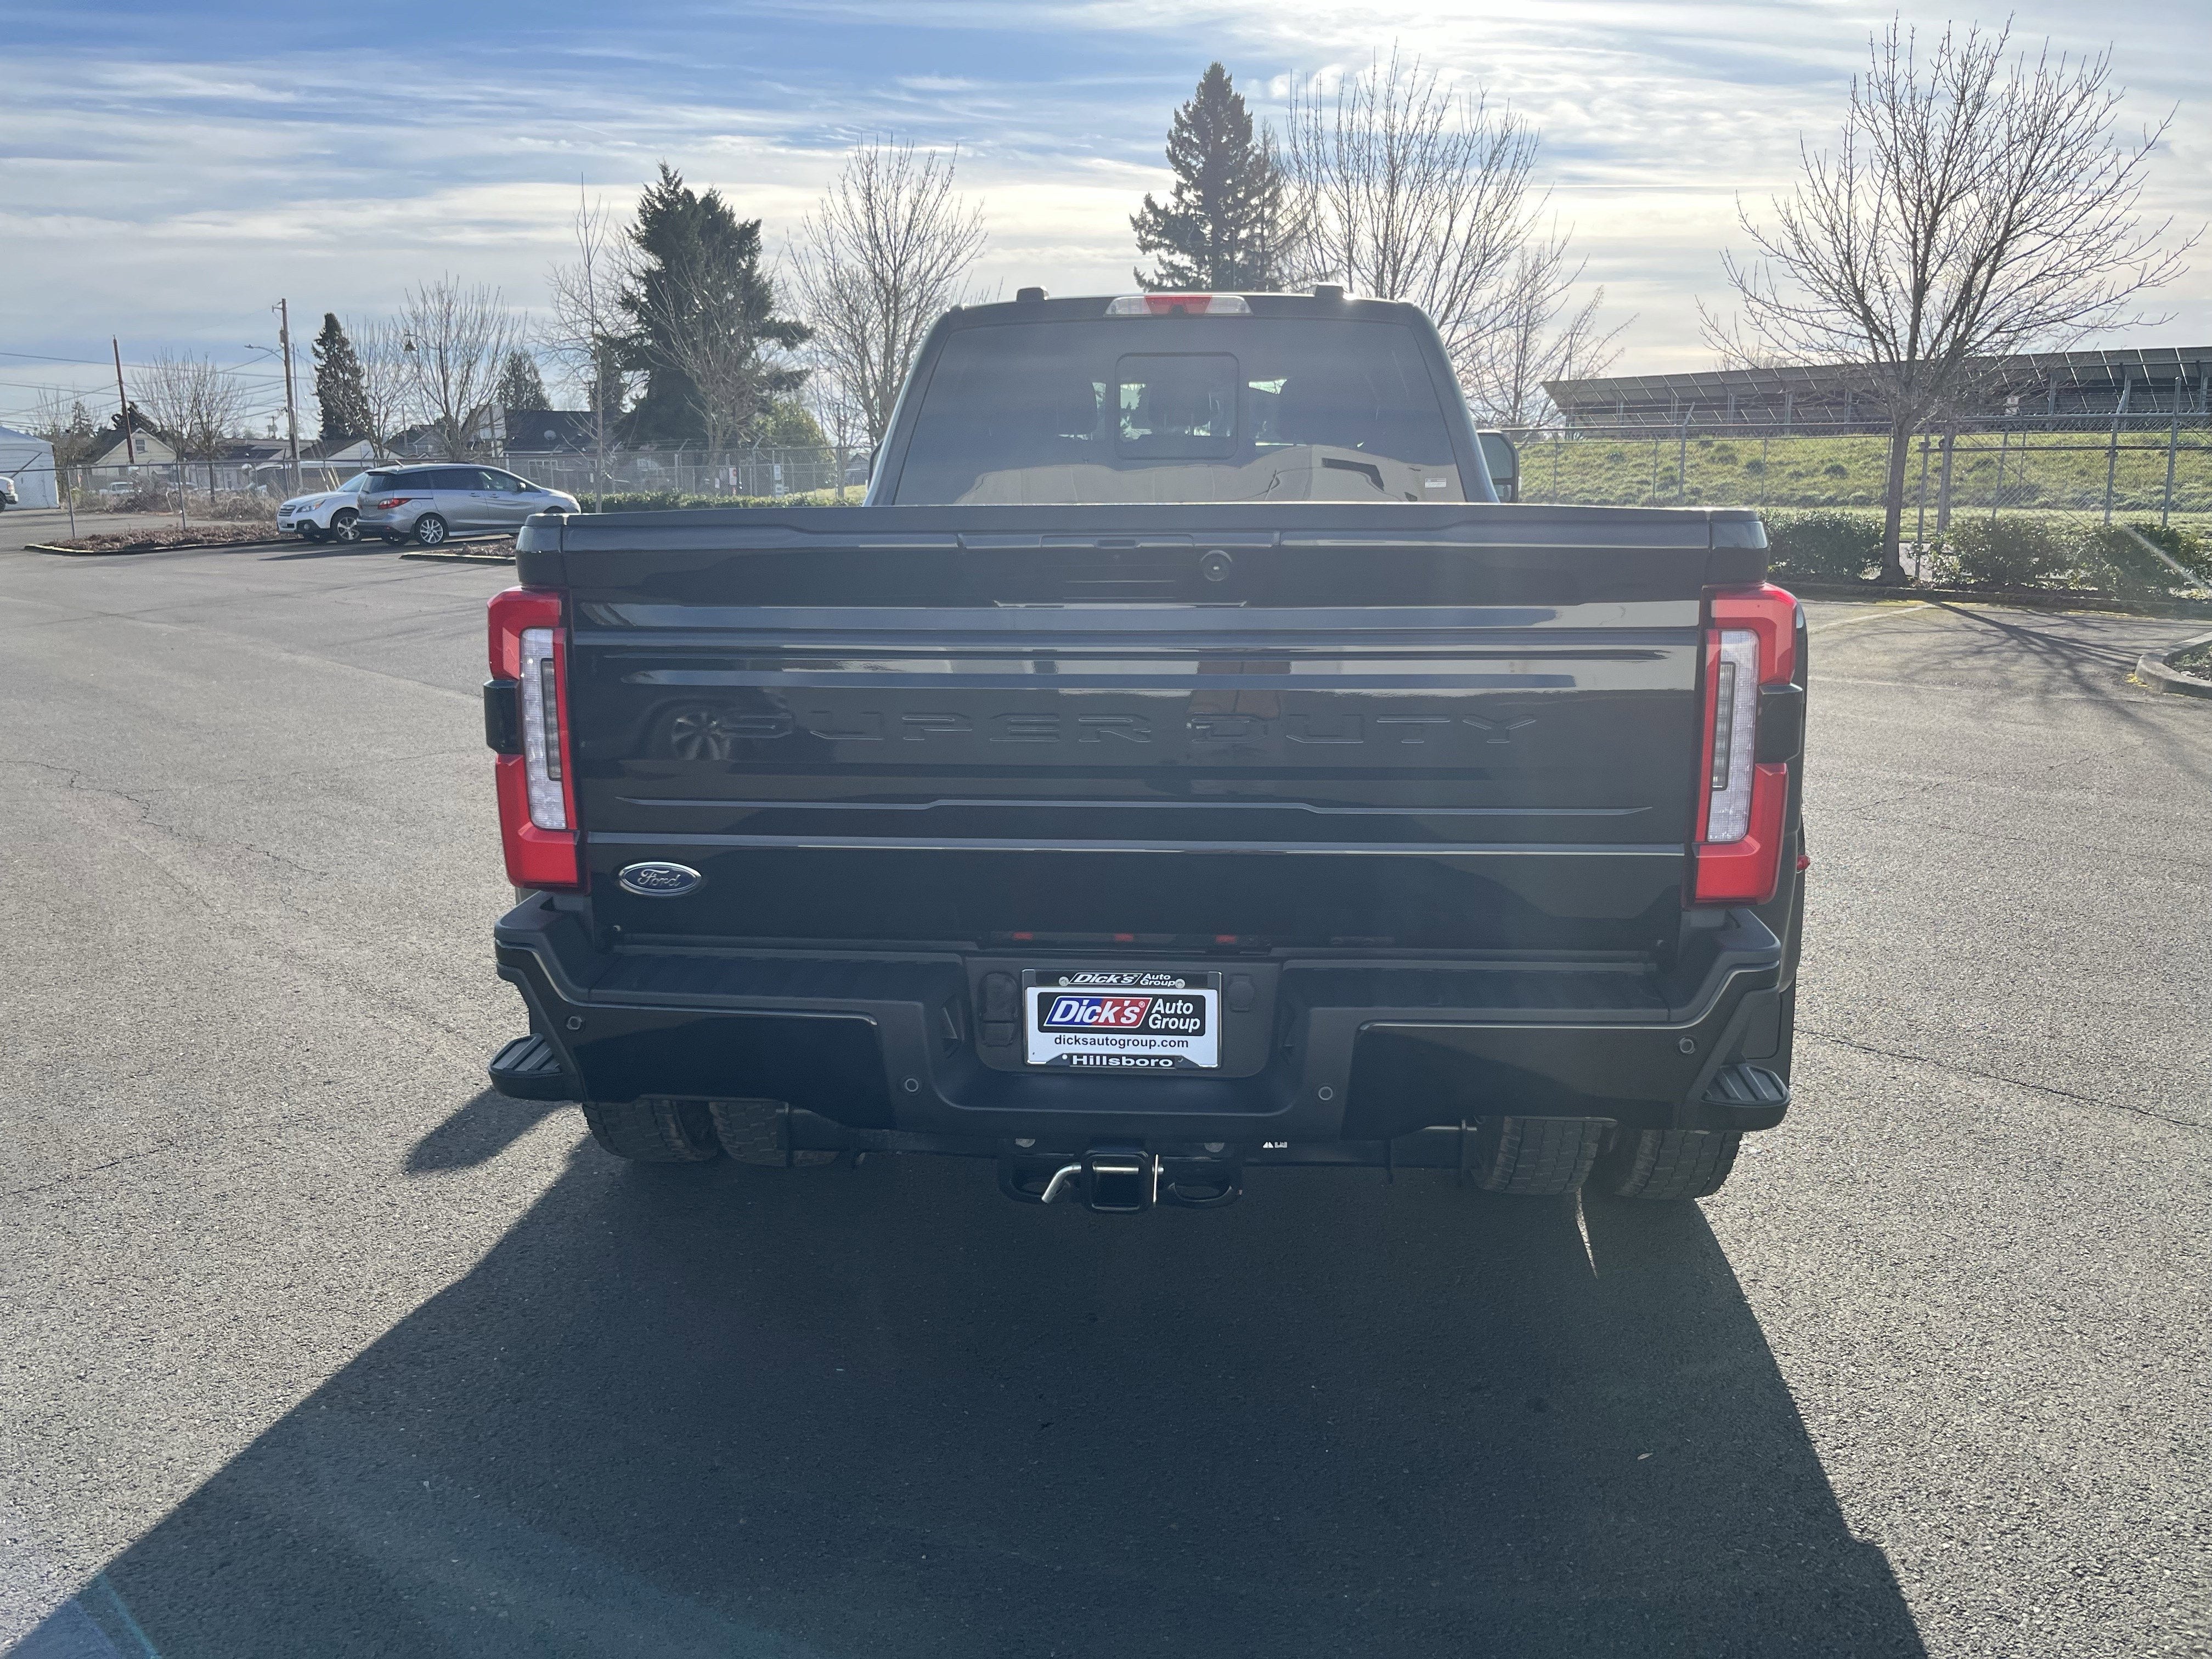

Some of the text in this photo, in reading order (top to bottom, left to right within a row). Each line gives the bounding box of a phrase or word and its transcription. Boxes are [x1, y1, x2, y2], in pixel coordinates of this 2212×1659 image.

[1190, 712, 1537, 744] DUTY
[637, 869, 681, 887] Ford
[1074, 973, 1136, 984] Dick's
[1051, 999, 1141, 1024] Dick's
[1152, 998, 1194, 1015] Auto
[1148, 1014, 1201, 1032] Group
[1054, 1035, 1189, 1049] dicksautogroup.com
[1073, 1055, 1173, 1067] Hillsboro
